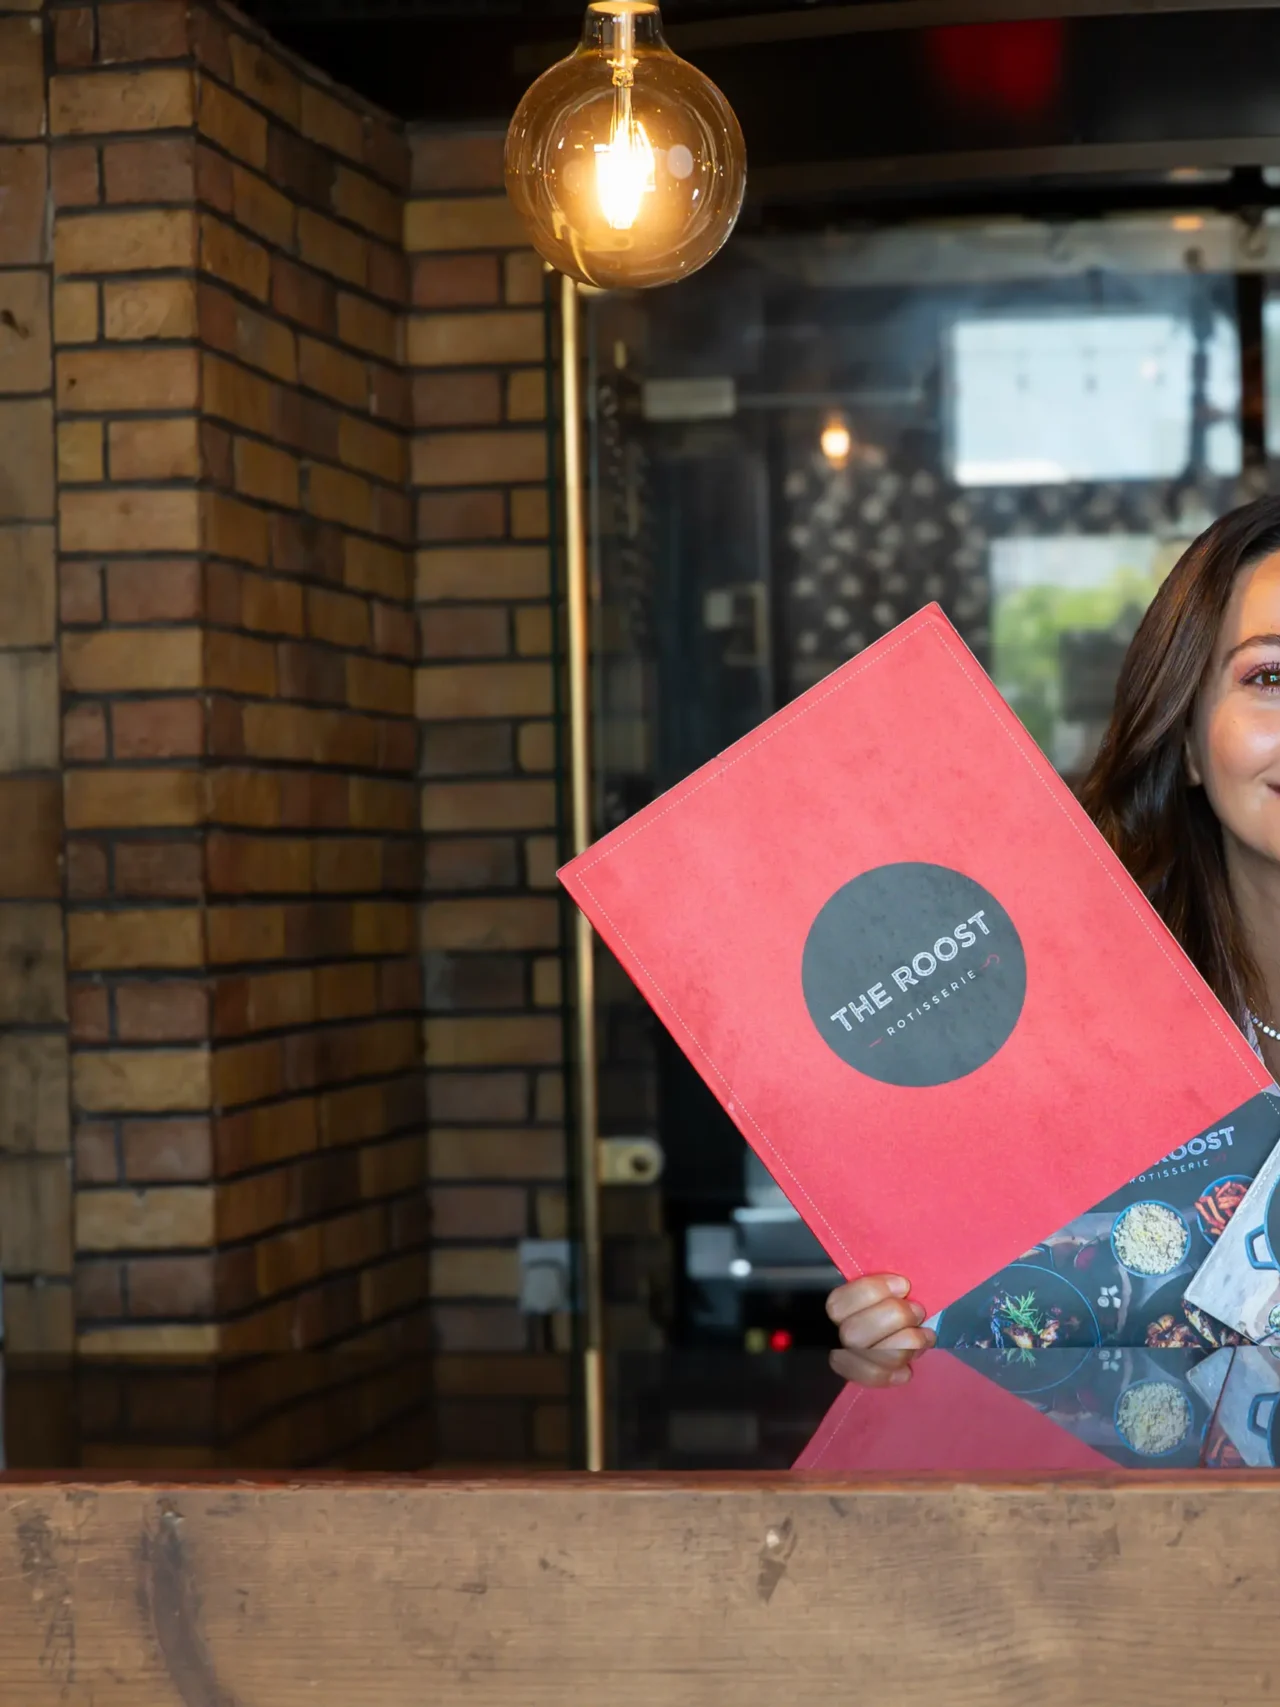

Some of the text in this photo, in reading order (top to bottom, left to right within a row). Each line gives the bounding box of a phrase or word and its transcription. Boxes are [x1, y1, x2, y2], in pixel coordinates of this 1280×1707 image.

[830, 910, 990, 1032] THE ROOST
[886, 969, 976, 1036] ROTISSERIE
[1154, 1125, 1235, 1166] OOST
